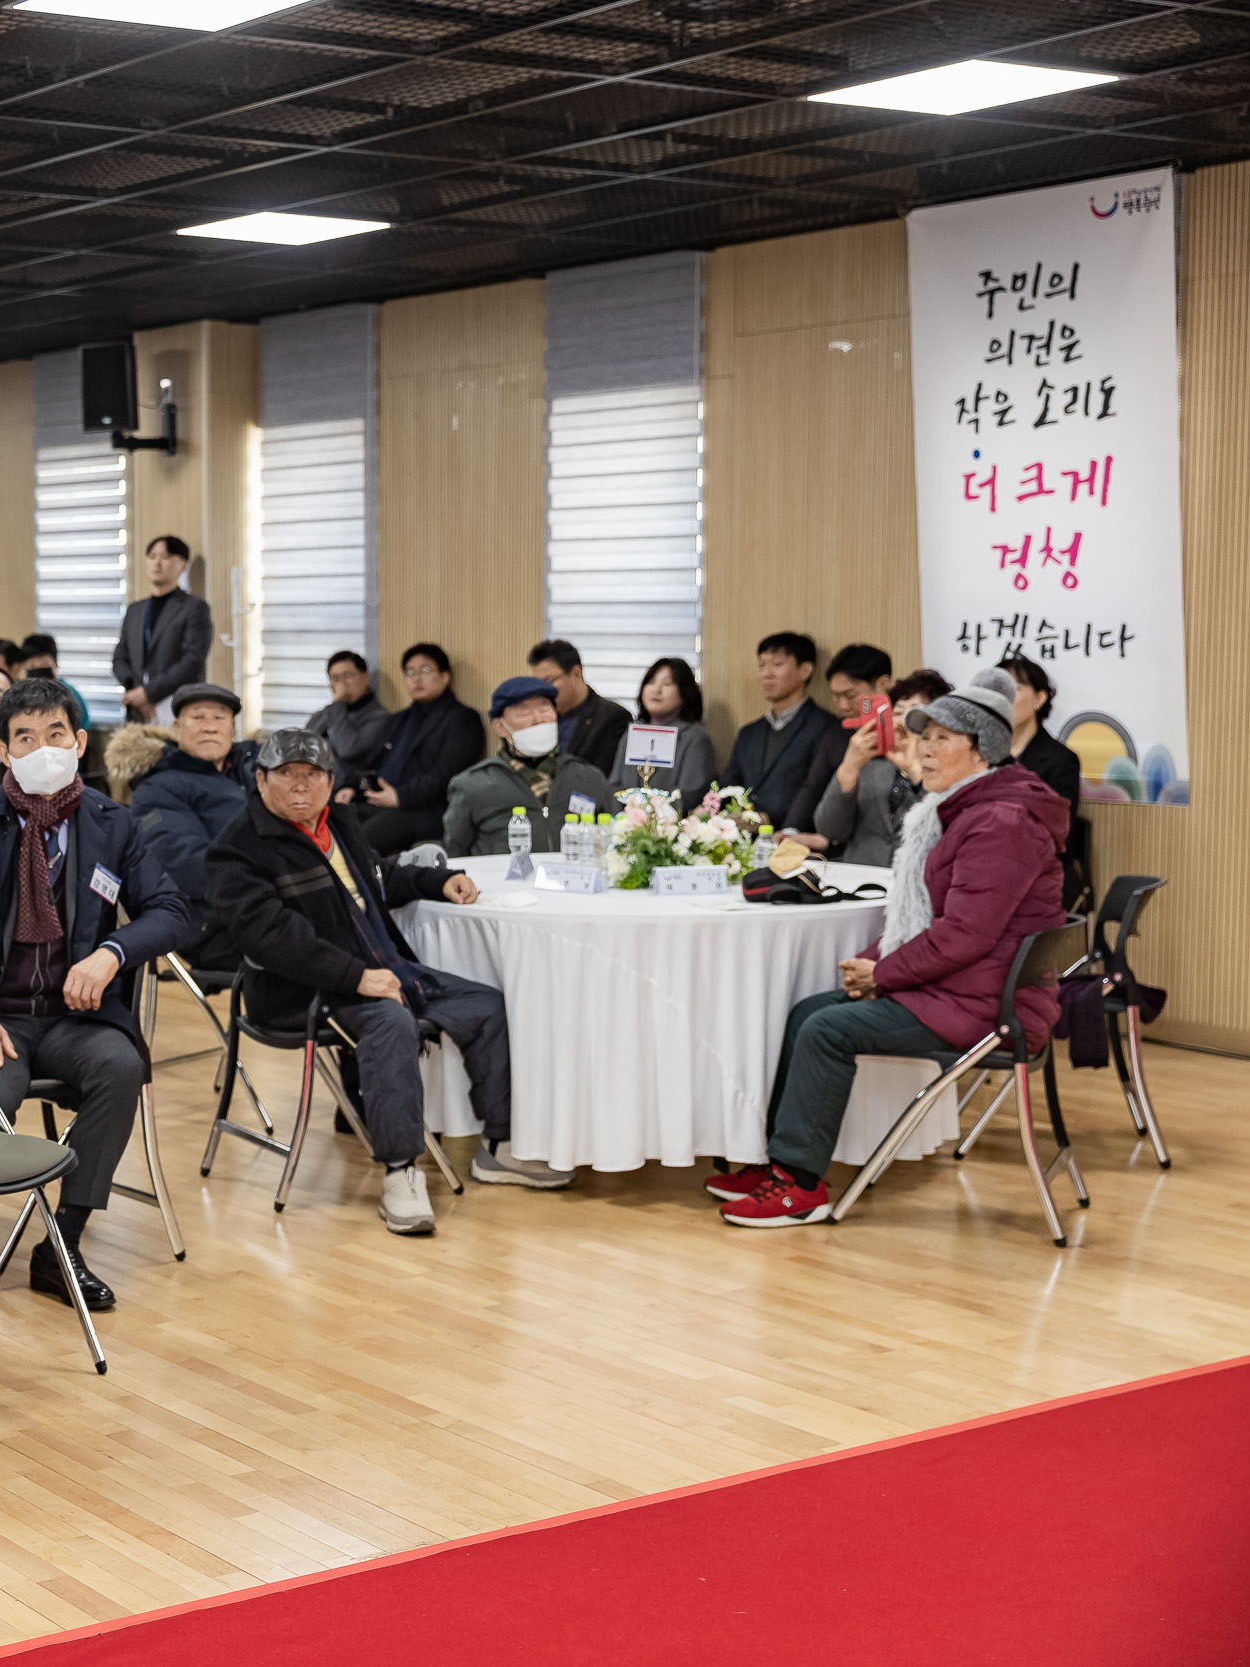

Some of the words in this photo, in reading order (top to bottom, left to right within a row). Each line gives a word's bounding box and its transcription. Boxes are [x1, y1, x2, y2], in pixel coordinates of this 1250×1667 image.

[976, 261, 1080, 319] 주민의
[984, 320, 1083, 367] 의견은
[955, 381, 1017, 434] 작은
[1033, 376, 1117, 429] 소리도
[963, 465, 997, 513] 더
[1016, 455, 1113, 507] 크게
[991, 526, 1082, 590] 경청
[956, 613, 1135, 661] 하겠습니다
